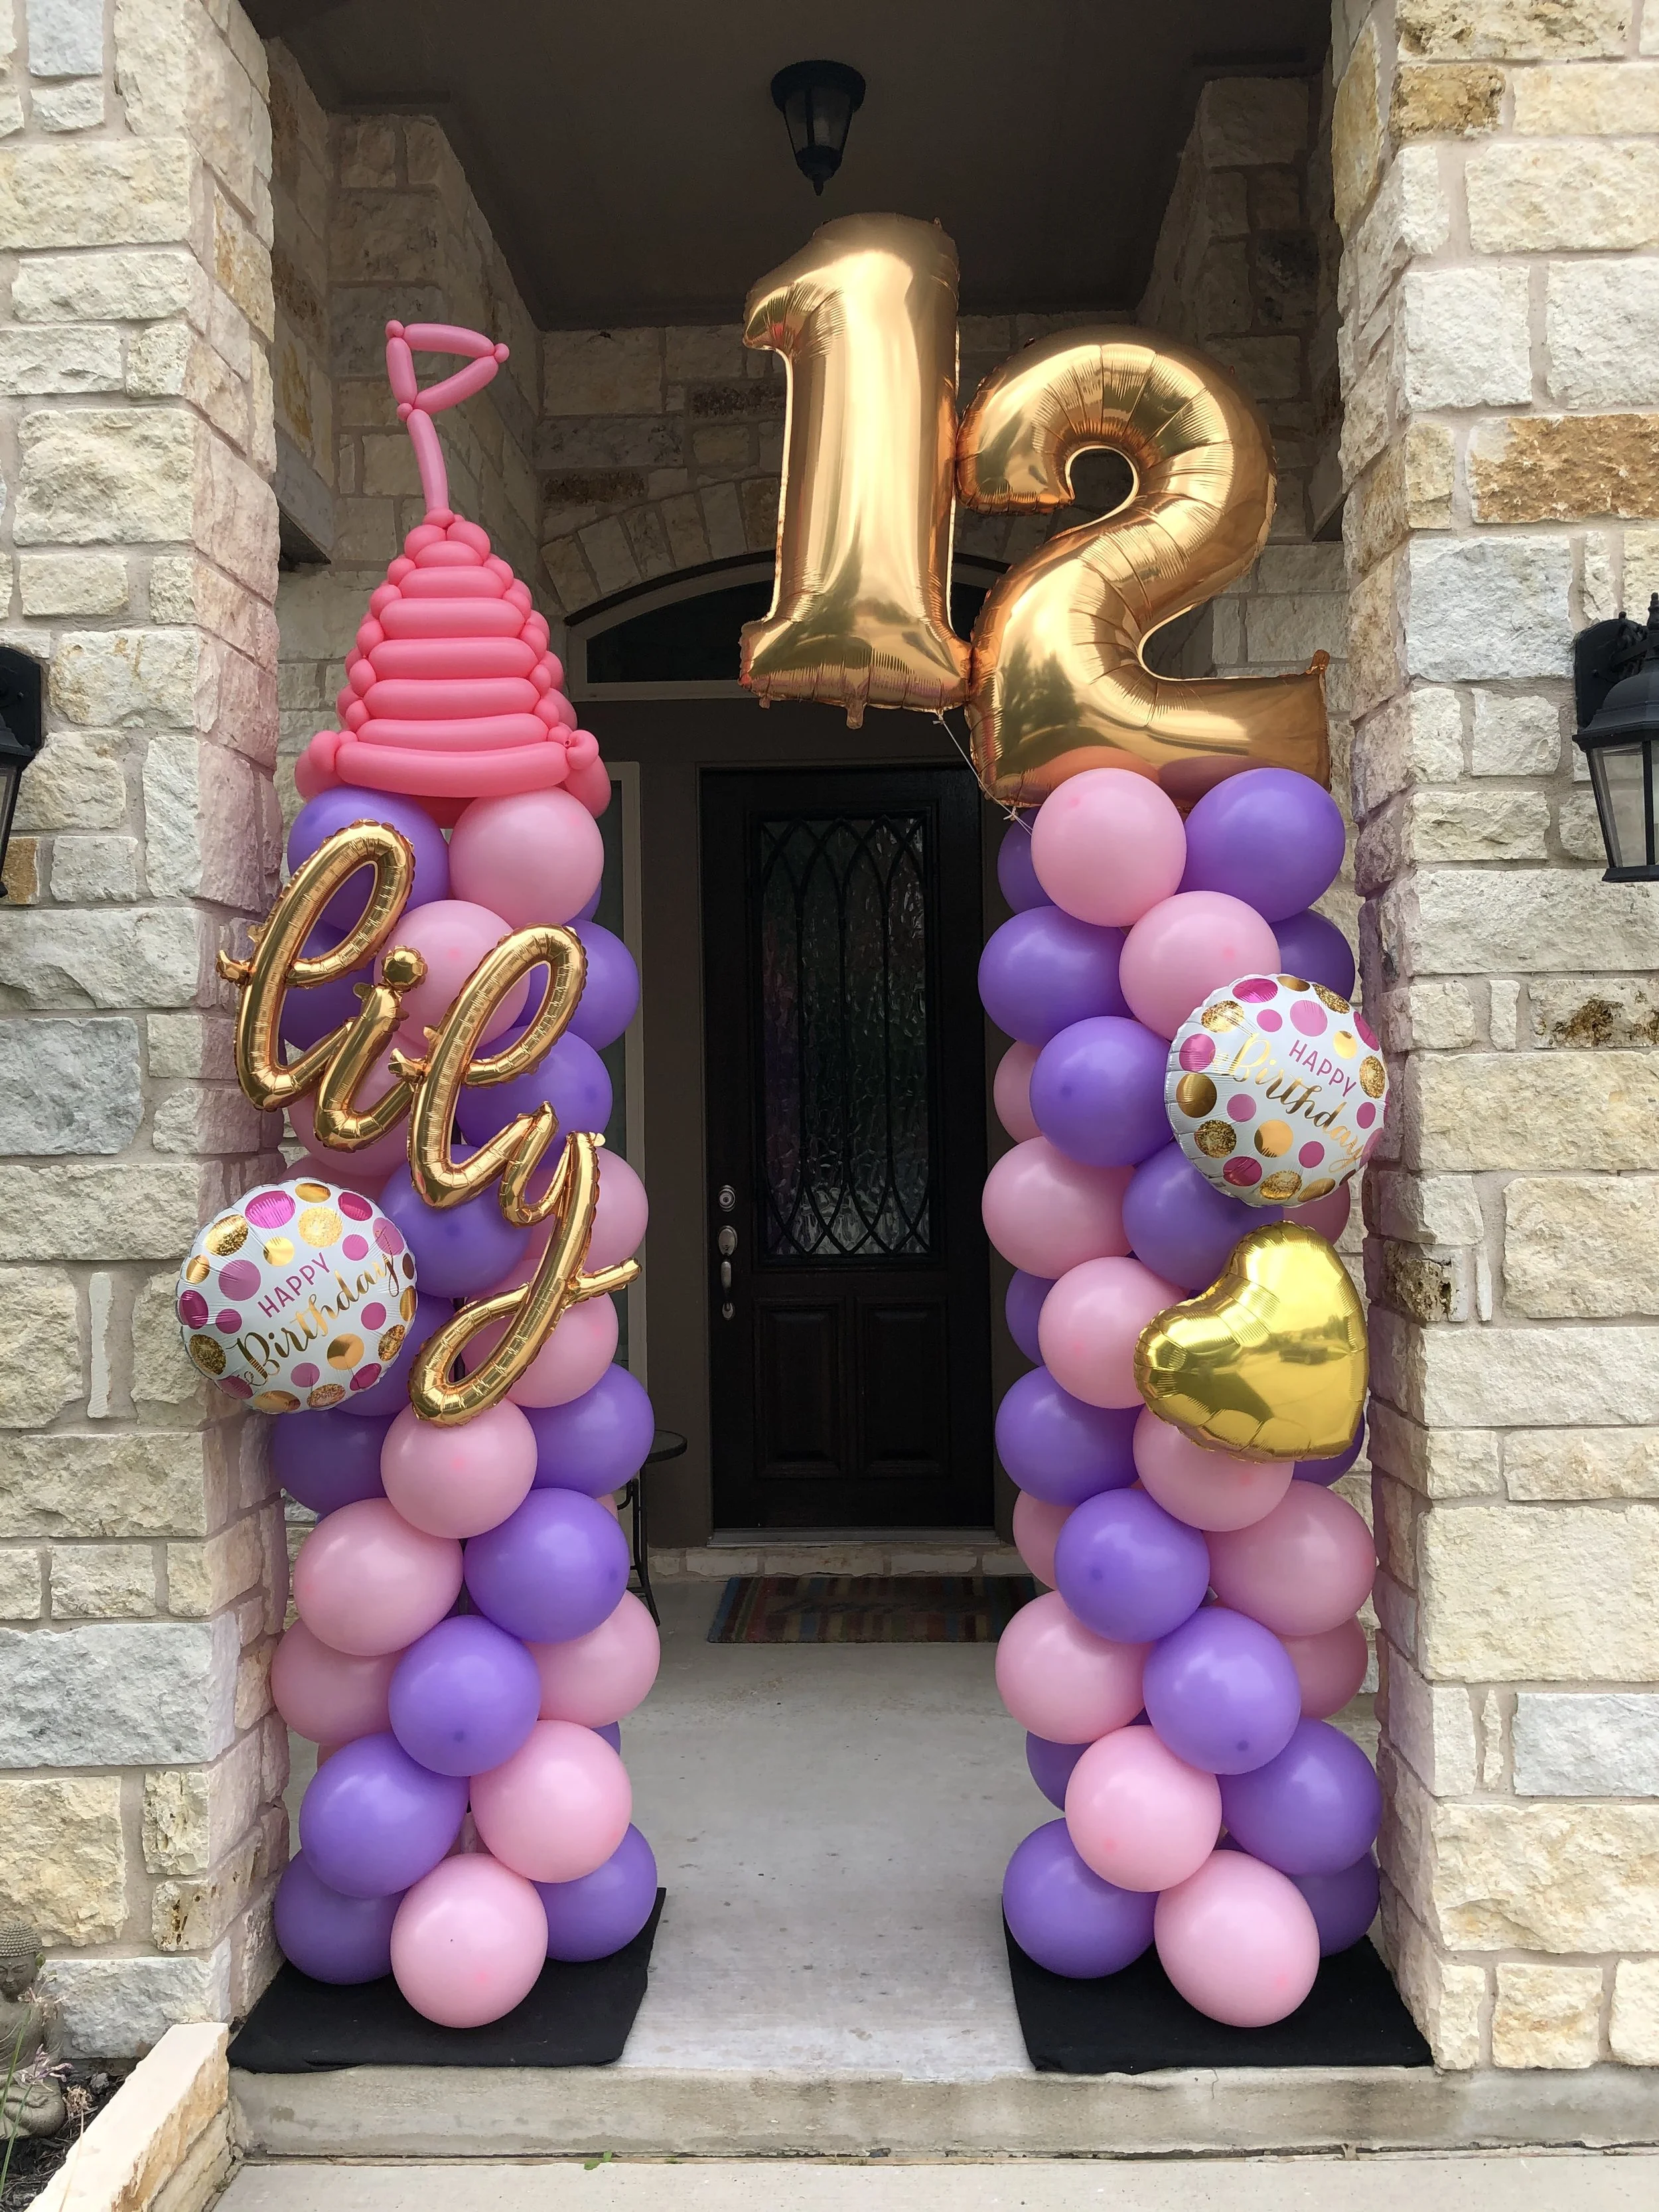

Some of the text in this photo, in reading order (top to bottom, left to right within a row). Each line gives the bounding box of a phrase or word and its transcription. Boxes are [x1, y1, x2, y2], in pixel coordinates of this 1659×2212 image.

[738, 212, 1331, 807] 12
[1210, 1033, 1366, 1173] Birthday
[1289, 1040, 1356, 1097] HAPPY
[226, 1228, 399, 1386] Birthday
[257, 1252, 330, 1318] HAPPY
